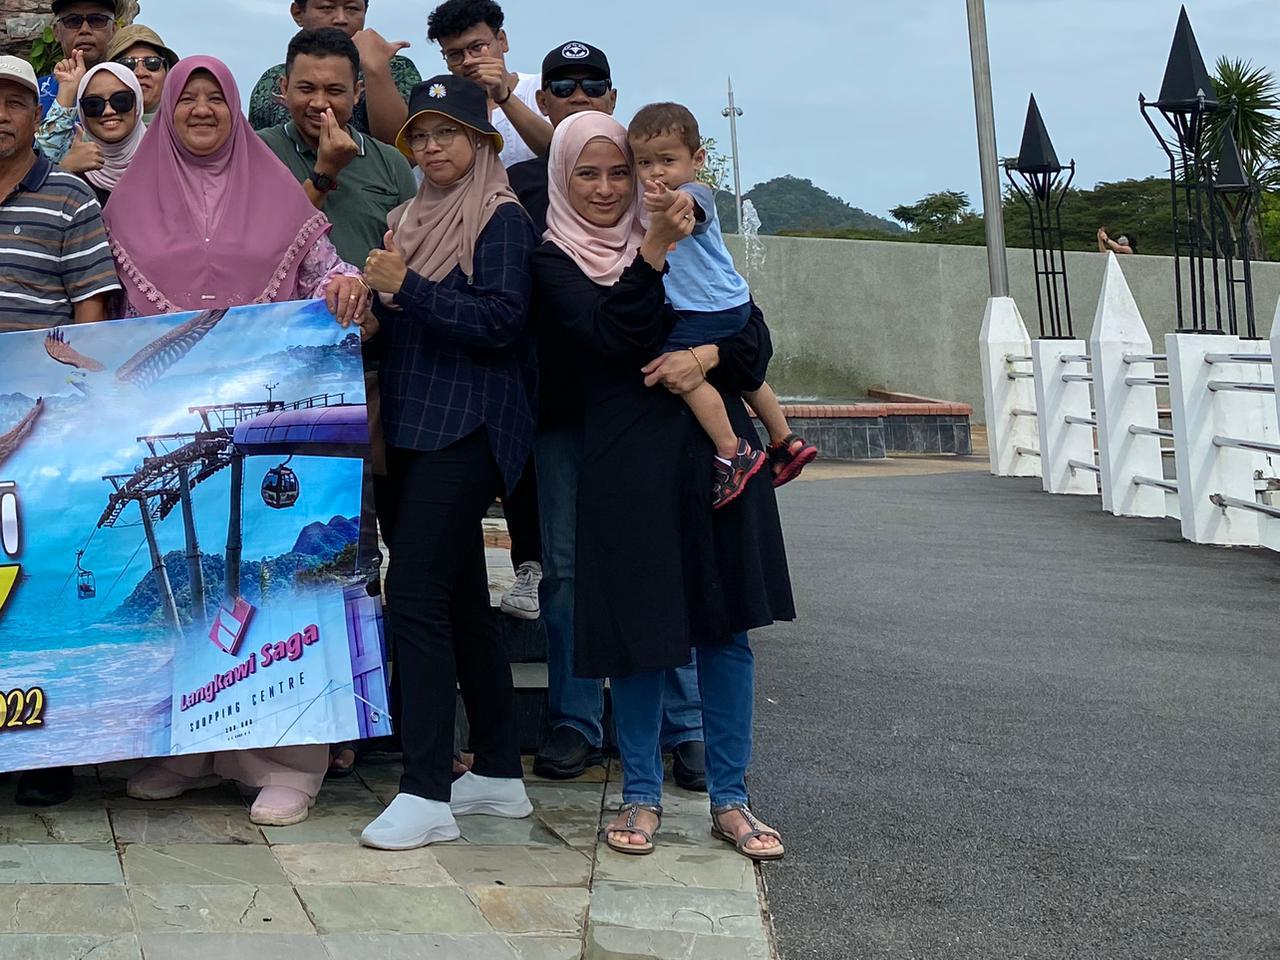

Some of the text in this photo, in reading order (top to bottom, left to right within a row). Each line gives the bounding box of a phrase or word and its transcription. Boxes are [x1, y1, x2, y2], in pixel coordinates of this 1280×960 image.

[180, 623, 320, 712] Langkawi Saga
[189, 701, 240, 732] SHOPPING
[251, 671, 305, 706] CENTRE
